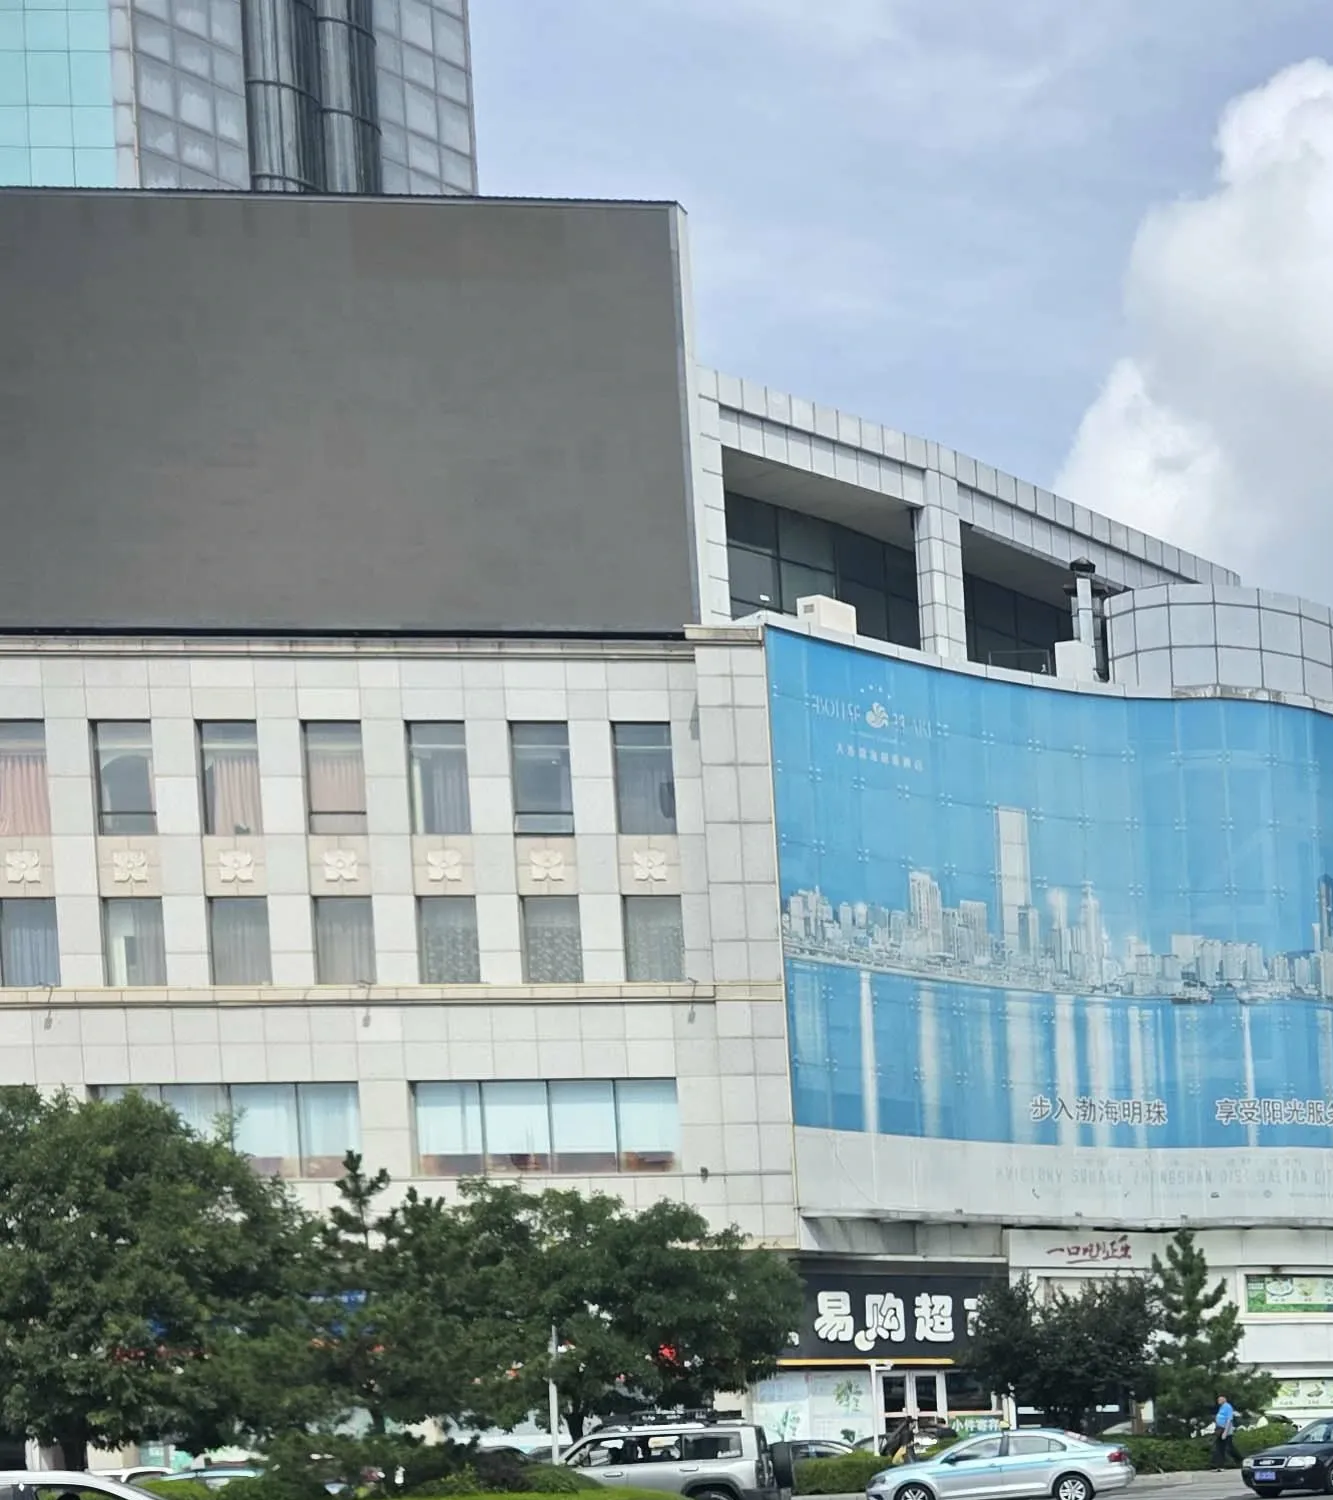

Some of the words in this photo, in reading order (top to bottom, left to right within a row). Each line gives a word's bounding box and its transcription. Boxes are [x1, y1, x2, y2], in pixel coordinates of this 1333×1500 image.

[1030, 1097, 1168, 1126] 步入渤海明珠
[788, 1290, 982, 1346] 易购超
